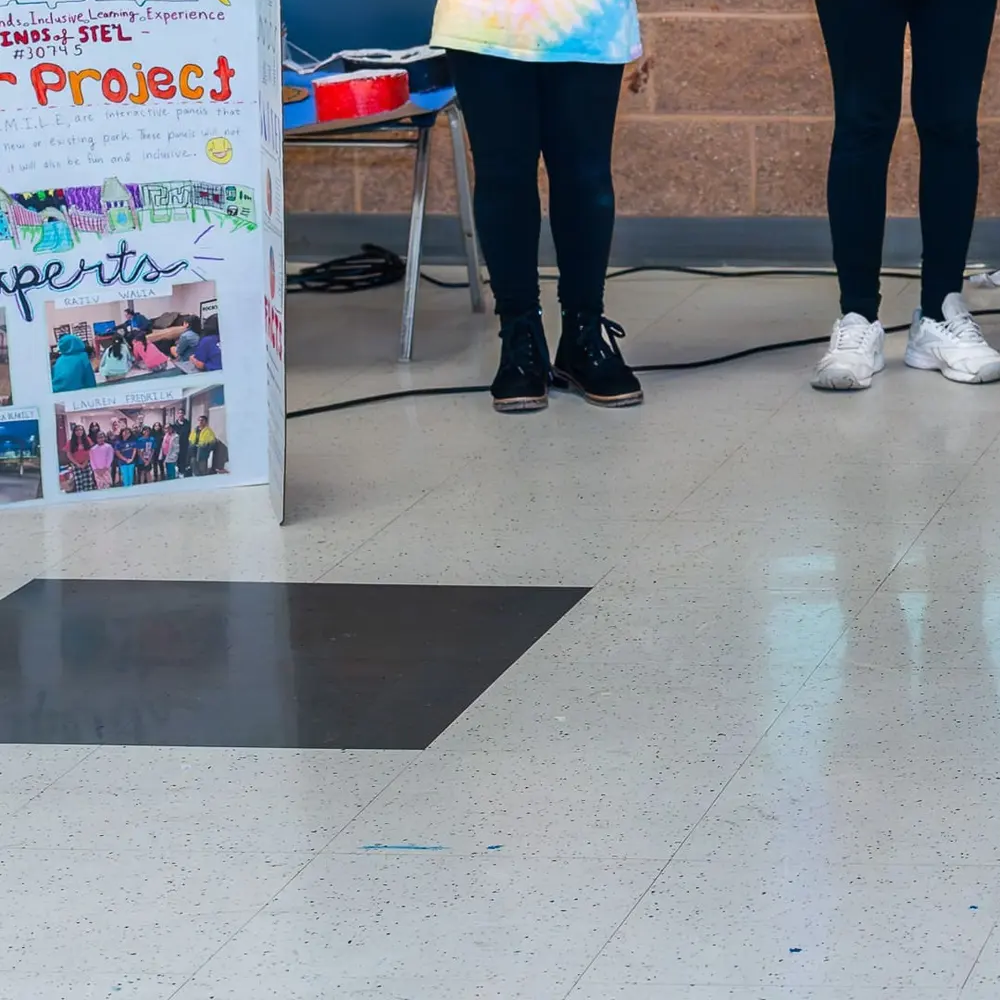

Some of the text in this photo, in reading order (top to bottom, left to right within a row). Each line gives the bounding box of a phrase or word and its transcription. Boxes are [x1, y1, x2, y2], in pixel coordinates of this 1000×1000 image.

[146, 6, 226, 25] Experience
[53, 28, 75, 45] of
[13, 44, 83, 59] #30745
[30, 55, 236, 106] Project
[74, 113, 94, 123] are
[105, 108, 170, 119] interactive
[176, 107, 208, 120] panels
[216, 106, 241, 116] that
[3, 142, 25, 152] new
[49, 135, 95, 151] existing
[137, 128, 161, 140] These
[167, 130, 196, 143] panels
[224, 127, 240, 137] not
[20, 160, 36, 172] will
[43, 159, 61, 169] also
[67, 156, 80, 166] be
[87, 152, 104, 164] fun
[110, 151, 131, 163] and
[118, 288, 156, 299] WALIA
[73, 397, 116, 411] LAUREN
